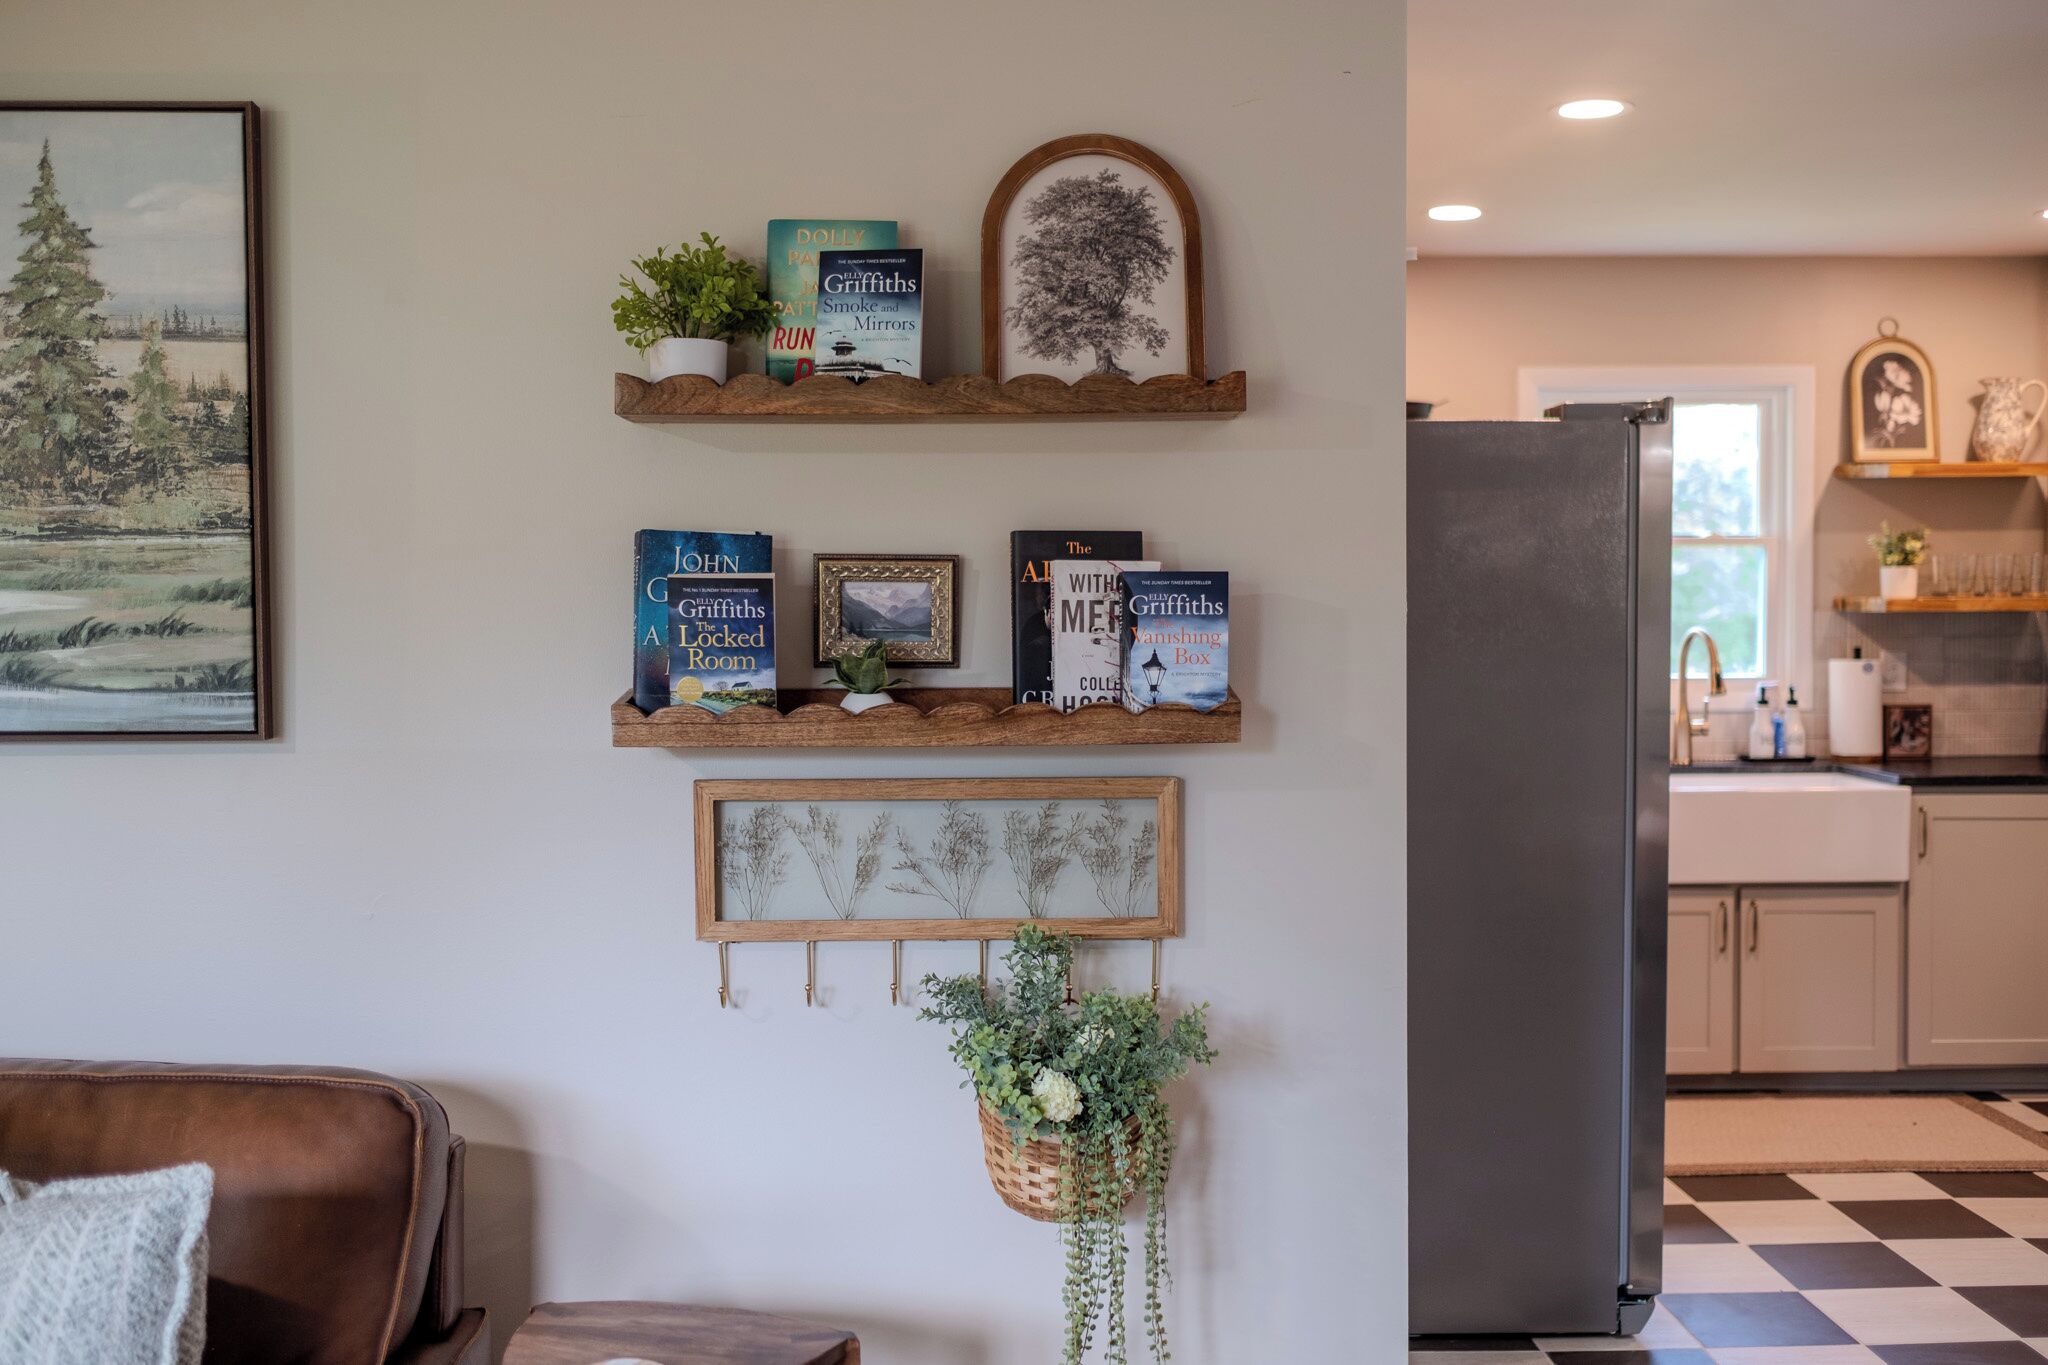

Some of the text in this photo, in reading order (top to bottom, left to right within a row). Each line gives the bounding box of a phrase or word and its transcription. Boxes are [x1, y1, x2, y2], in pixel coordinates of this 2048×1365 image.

[797, 229, 865, 246] DOLLY
[824, 271, 916, 293] Griffiths
[823, 297, 899, 313] Smoke and
[853, 315, 915, 331] Mirrors
[773, 326, 815, 350] RUN
[1066, 541, 1092, 554] The
[673, 545, 740, 574] JOHN
[1069, 573, 1120, 593] WITH
[678, 598, 766, 619] Griffiths
[1128, 593, 1224, 616] Griffiths
[678, 624, 766, 648] Locked
[696, 621, 716, 632] The
[1130, 625, 1222, 650] Vanishing
[687, 648, 758, 670] Room
[1175, 646, 1211, 666] Box
